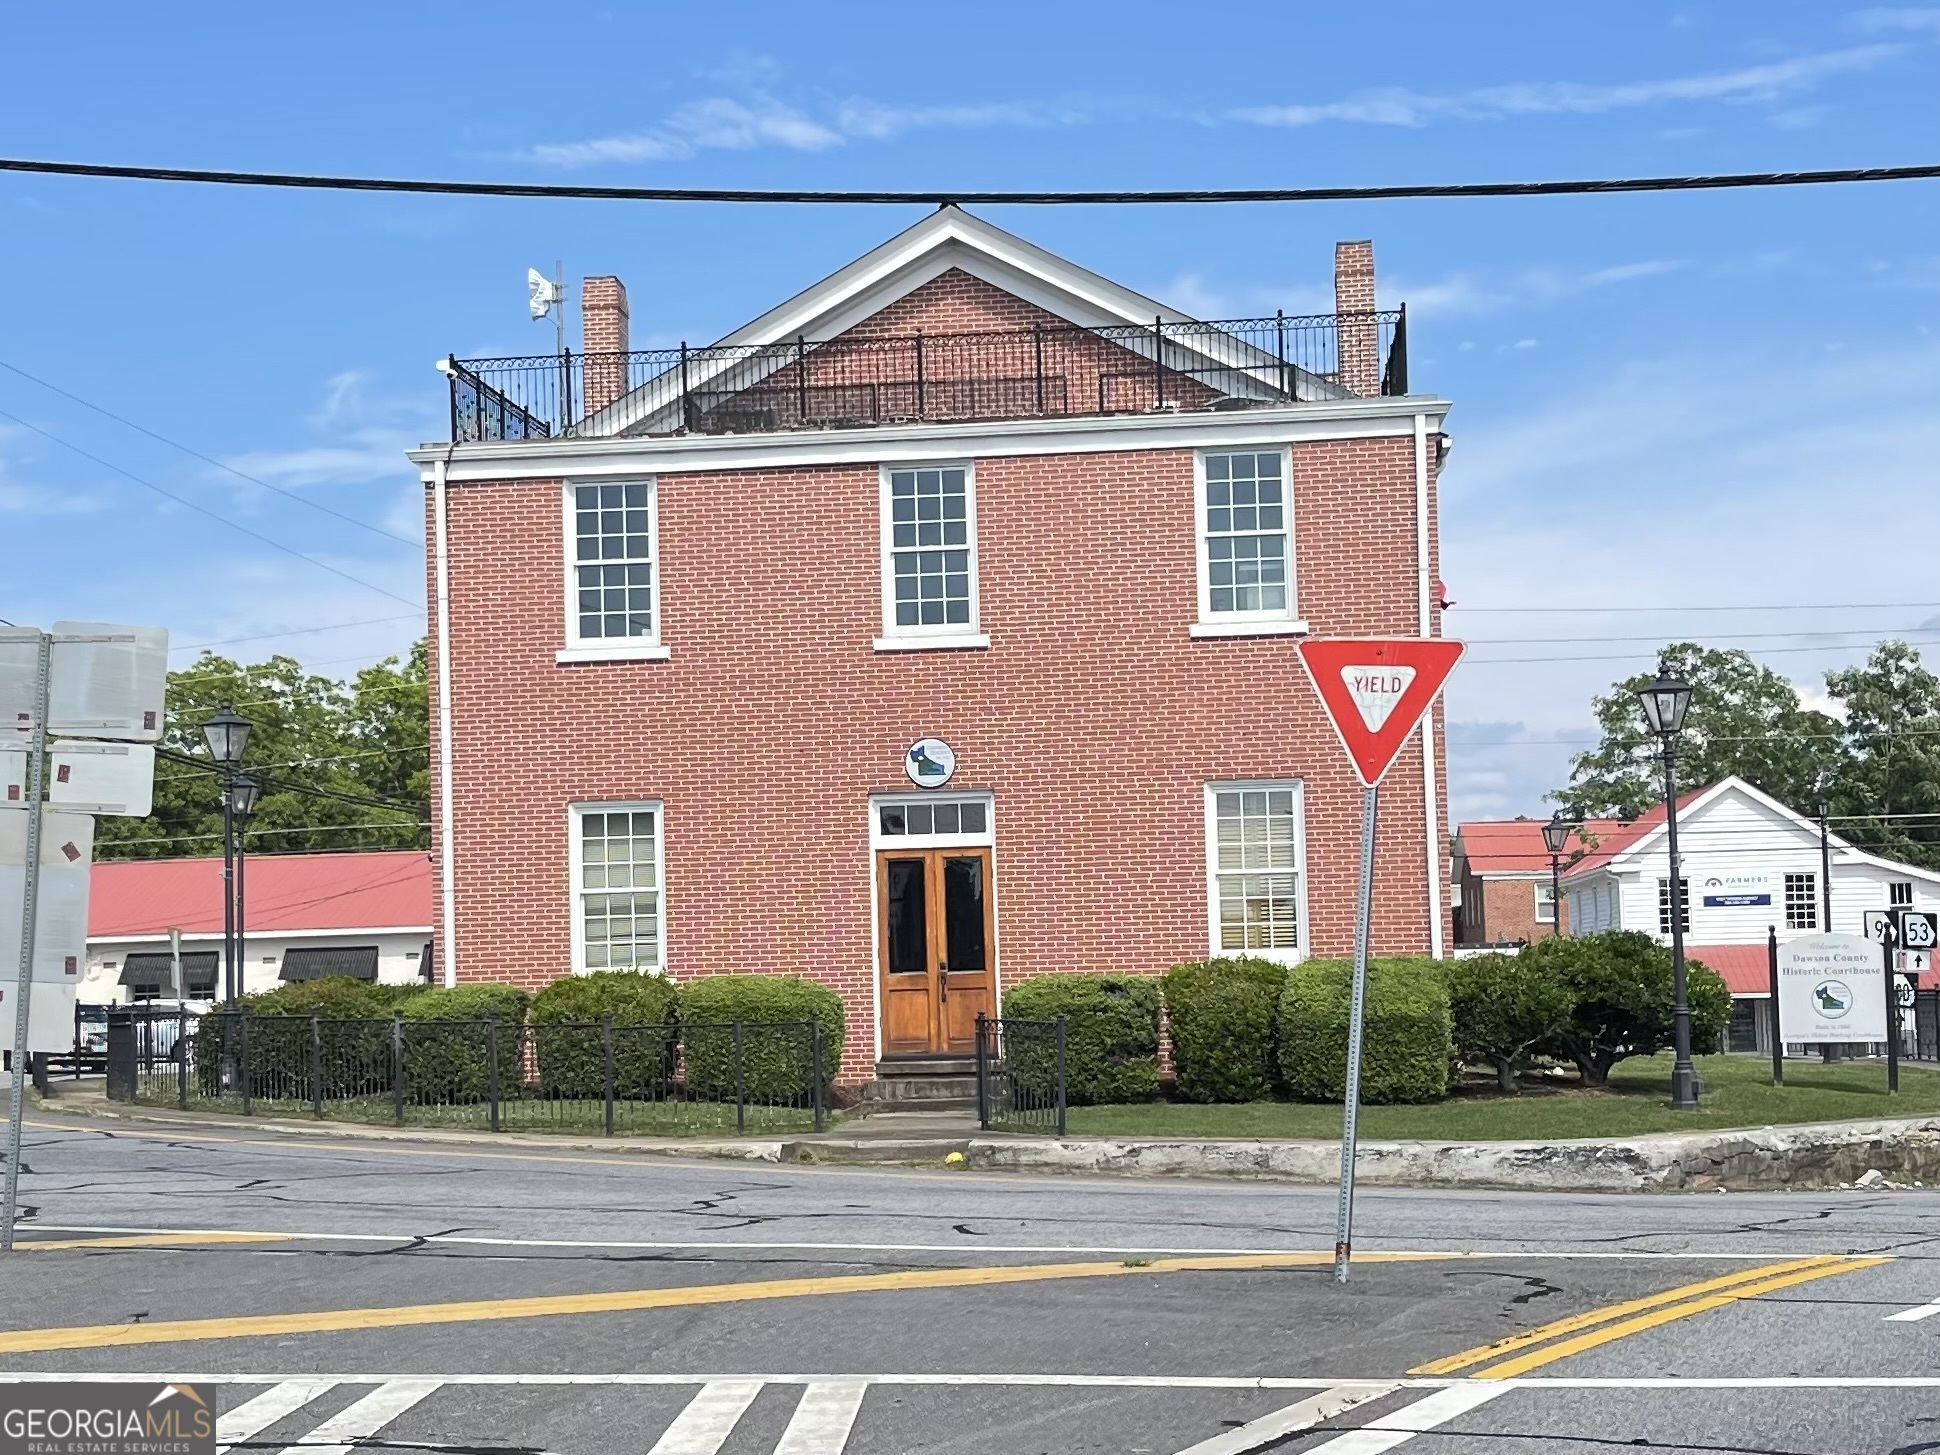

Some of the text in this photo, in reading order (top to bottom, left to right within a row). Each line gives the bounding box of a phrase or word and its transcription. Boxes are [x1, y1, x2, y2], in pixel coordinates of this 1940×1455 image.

[1354, 676, 1402, 693] YIELD
[1874, 921, 1883, 938] 9
[1909, 923, 1929, 941] 53
[1792, 954, 1869, 963] Dawson County
[1782, 966, 1881, 976] Historic Courthouse
